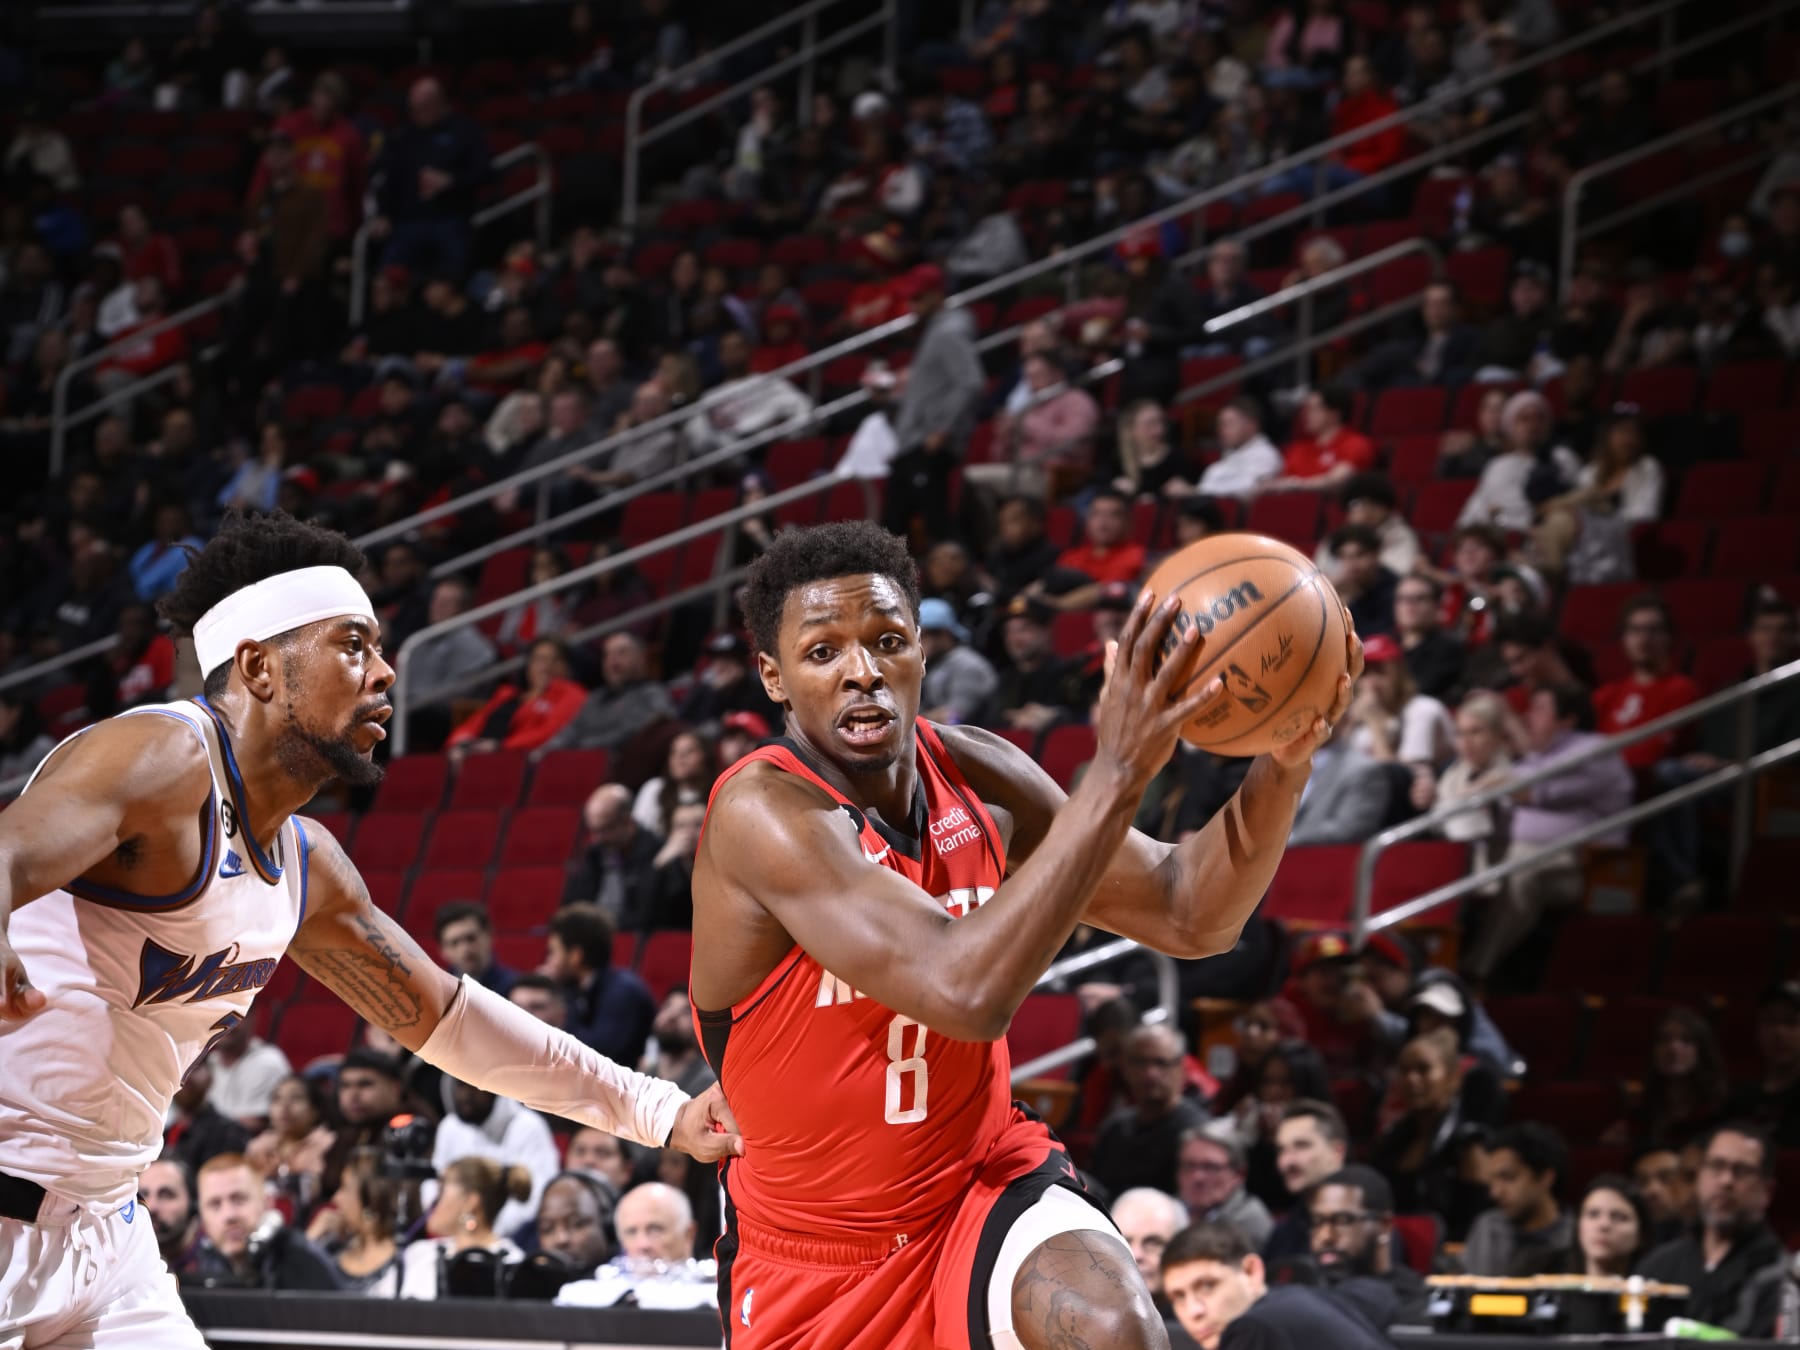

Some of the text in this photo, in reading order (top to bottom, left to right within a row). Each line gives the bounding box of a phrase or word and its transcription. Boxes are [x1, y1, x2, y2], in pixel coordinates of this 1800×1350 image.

[929, 808, 969, 836] credit
[934, 824, 982, 855] karma
[885, 1013, 928, 1125] 8
